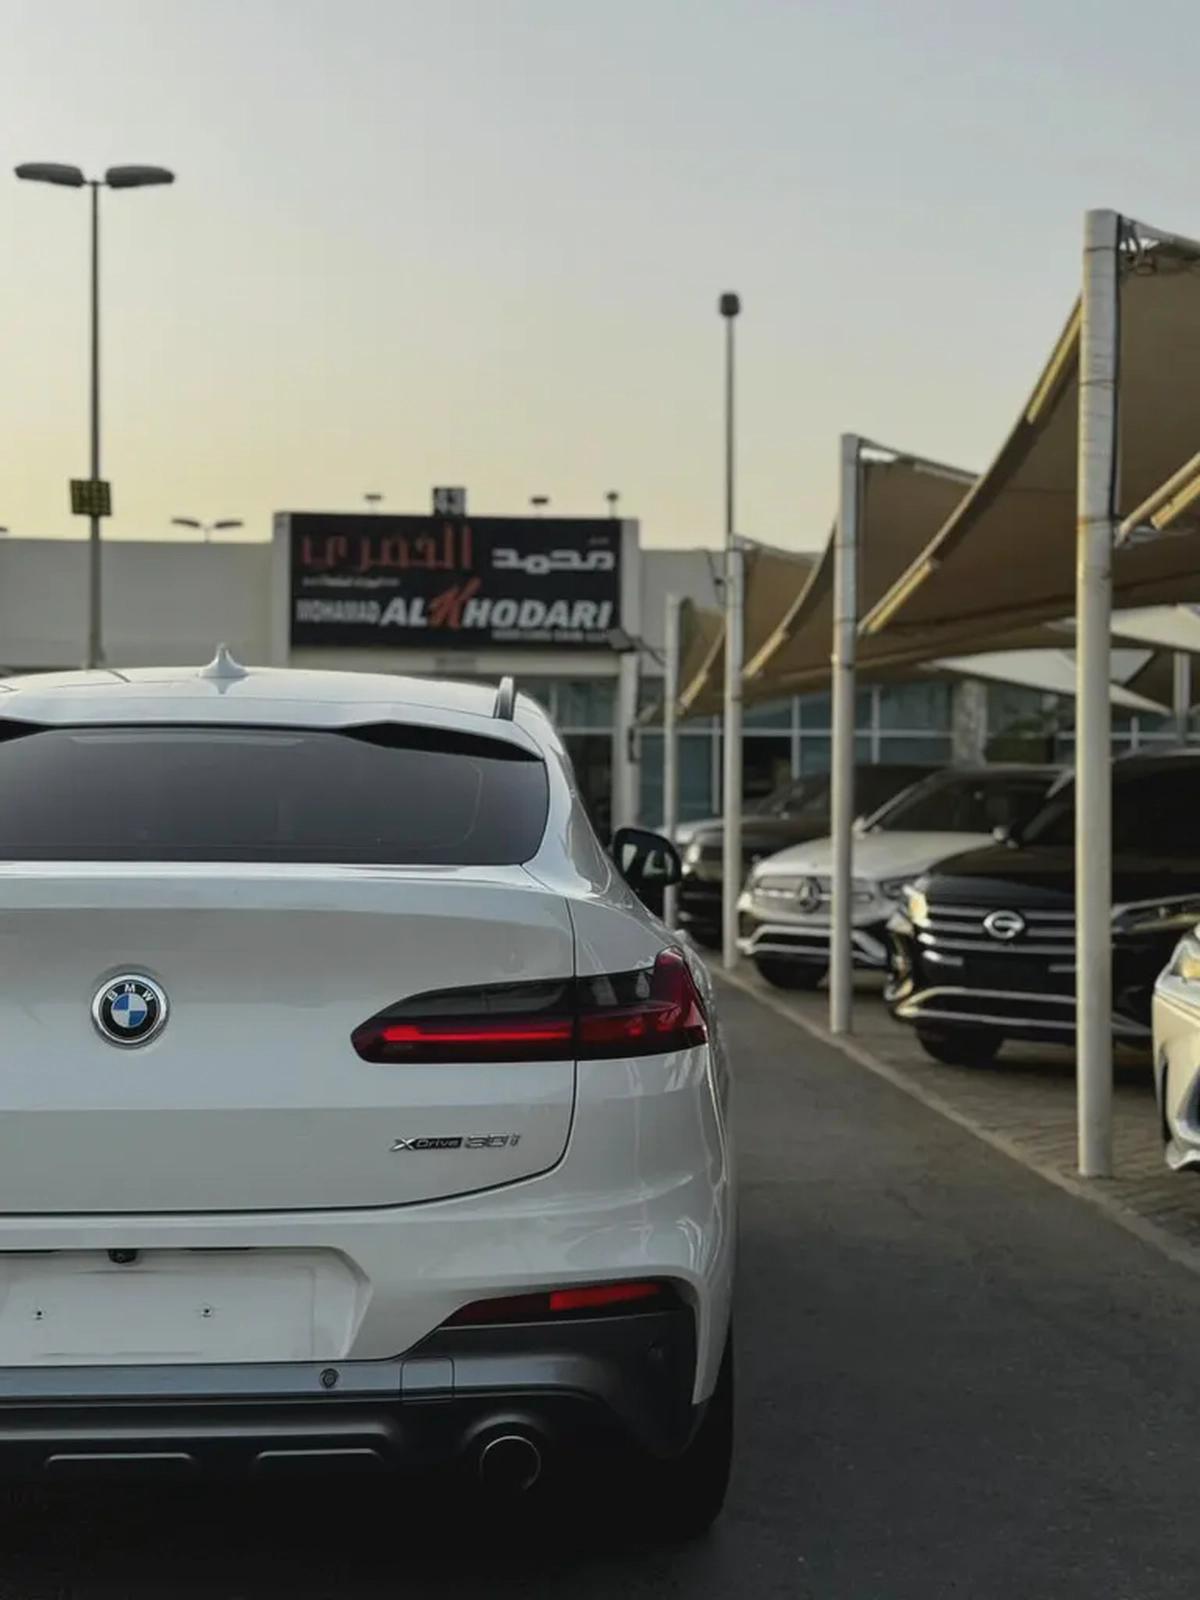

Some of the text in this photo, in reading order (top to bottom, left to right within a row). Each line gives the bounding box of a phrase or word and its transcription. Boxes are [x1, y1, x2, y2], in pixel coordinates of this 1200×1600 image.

[492, 547, 615, 575] محمد
[379, 597, 428, 628] AL
[106, 983, 155, 1002] BMW
